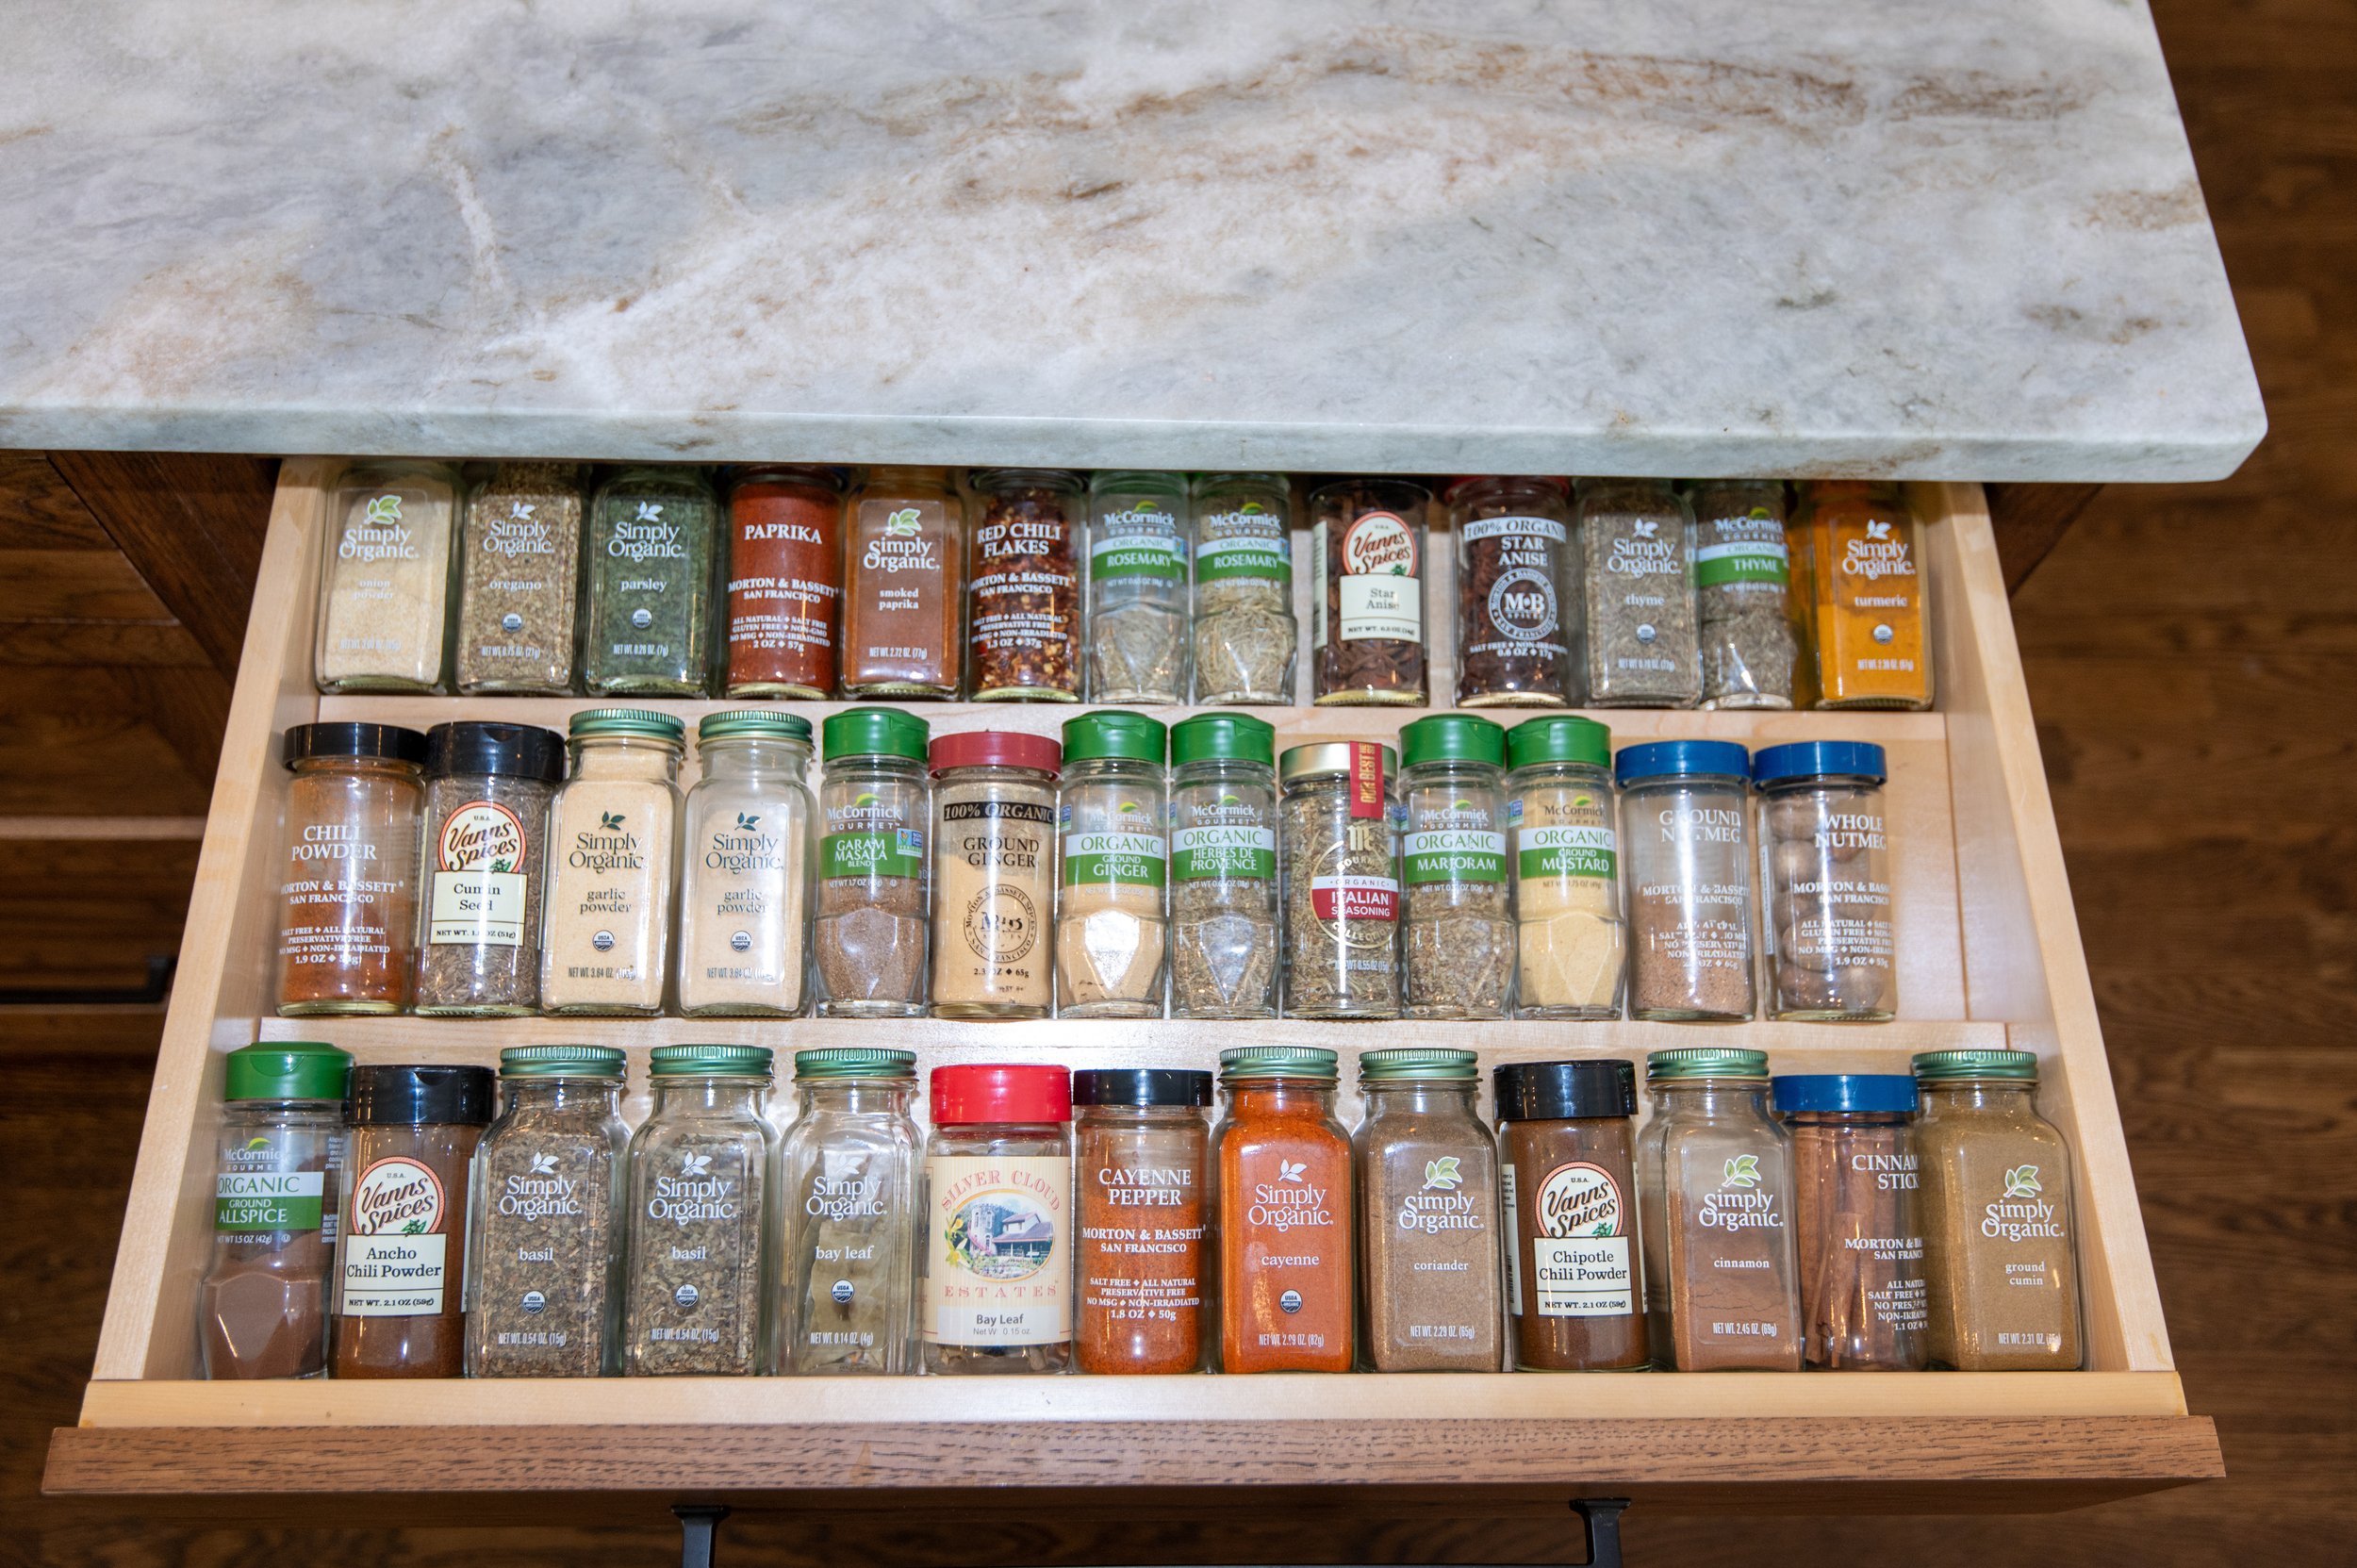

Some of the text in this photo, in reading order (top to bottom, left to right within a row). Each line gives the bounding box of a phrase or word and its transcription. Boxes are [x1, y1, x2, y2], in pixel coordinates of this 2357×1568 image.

[1104, 511, 1176, 527] McCormick
[1211, 512, 1280, 528] McCormick
[345, 526, 411, 545] Simply
[490, 520, 551, 539] Simply
[615, 521, 680, 543] Simply
[744, 523, 822, 545] PAPRIKA
[978, 523, 1061, 544] RED CHILI
[869, 536, 931, 557] Simply
[984, 539, 1049, 558] FLAKES
[1113, 538, 1167, 549] ORGANIC
[1354, 532, 1406, 557] Vanns
[1501, 536, 1544, 551] STAR
[1614, 538, 1675, 558] Simply
[1847, 538, 1908, 559] Simply
[1107, 553, 1172, 567] ROSEMARY
[1214, 554, 1278, 569] ROSEMARY
[1356, 547, 1411, 574] Spices
[1498, 552, 1547, 566] ANISE
[1733, 560, 1779, 572] THYME
[489, 581, 541, 591] oregano
[621, 578, 668, 592] parsley
[729, 578, 833, 598] MORTON & BASSETT
[980, 585, 1052, 597] SAN FRANCISCO
[744, 590, 820, 603] SAN FRANCISCO
[880, 588, 918, 598] smoked
[1371, 588, 1394, 598] Star
[1626, 595, 1665, 606] thyme
[1854, 595, 1907, 605] turmeric
[879, 600, 918, 611] paprika
[827, 805, 902, 821] McCormick
[945, 804, 1053, 824] 100% ORGANIC
[1191, 804, 1256, 817] McCormick
[1423, 809, 1489, 825] McCormick
[1544, 805, 1605, 817] McCormick
[1824, 815, 1883, 832] WHOLE
[304, 826, 359, 842] CHILI
[449, 822, 511, 851] Vanns
[1184, 830, 1262, 846] ORGANIC
[1416, 833, 1495, 850] ORGANIC
[1535, 830, 1611, 846] ORGANIC
[1816, 833, 1886, 849] NUTMEG
[577, 832, 641, 853] Simply
[713, 834, 779, 853] Simply
[837, 839, 885, 850] GARAM
[964, 837, 1039, 852] GROUND
[1081, 836, 1159, 853] ORGANIC
[291, 844, 377, 861] POWDER
[449, 838, 517, 872] Spices
[834, 850, 887, 862] MASALA
[968, 852, 1035, 867] GINGER
[1102, 855, 1141, 864] GROUND
[1194, 848, 1254, 860] HERBES DE
[1558, 849, 1596, 857] GROUND
[1094, 864, 1148, 878] GINGER
[1191, 859, 1257, 870] PROVENCE
[1417, 856, 1496, 871] MARJORAM
[1541, 858, 1608, 871] MUSTARD
[587, 889, 626, 903] garlic
[724, 889, 762, 902] garlic
[580, 900, 632, 915] powder
[717, 901, 767, 916] powder
[1099, 1168, 1191, 1185] CAYENNE
[218, 1177, 300, 1194] ORGANIC
[506, 1176, 577, 1202] Simply
[656, 1176, 731, 1203] Simply
[813, 1176, 881, 1202] Simply
[943, 1169, 1061, 1211] SILVER CLOUD
[362, 1178, 428, 1213] Vanns
[1109, 1189, 1182, 1206] PEPPER
[1256, 1183, 1327, 1211] Simply
[1405, 1191, 1475, 1214] Simply
[1548, 1181, 1609, 1216] Vanns
[1705, 1188, 1773, 1213] Simply
[229, 1199, 272, 1208] GROUND
[1986, 1199, 2054, 1222] Simply
[219, 1209, 288, 1223] ALLSPICE
[361, 1194, 435, 1235] Spices
[1551, 1197, 1615, 1239] Spices
[1083, 1228, 1202, 1240] MORTON & BASSETT
[366, 1247, 417, 1260] Ancho
[519, 1247, 553, 1261] basil
[671, 1246, 706, 1260] basil
[815, 1246, 874, 1261] bay leaf
[1100, 1243, 1187, 1253] SAN FRANCISCO
[1261, 1255, 1320, 1268] cayenne
[1414, 1260, 1468, 1271] coriander
[1553, 1251, 1614, 1265] Chipotle
[1714, 1259, 1770, 1268] cinnamon
[347, 1264, 441, 1279] Chili Powder
[1540, 1268, 1627, 1280] Chili Powder
[2005, 1262, 2045, 1274] ground
[1090, 1278, 1195, 1287] SALT FREE ALL NATURAL
[2010, 1277, 2043, 1285] cumin
[945, 1285, 1057, 1297] ESTATES
[1101, 1288, 1162, 1296] PRESERVATIVE
[1099, 1297, 1117, 1306] MSG
[1128, 1297, 1199, 1306] NON-IRRADIATED
[977, 1313, 1024, 1327] Bay Leaf
[1111, 1310, 1177, 1320] 1.8 OZ 50g
[1713, 1323, 1723, 1334] NET
